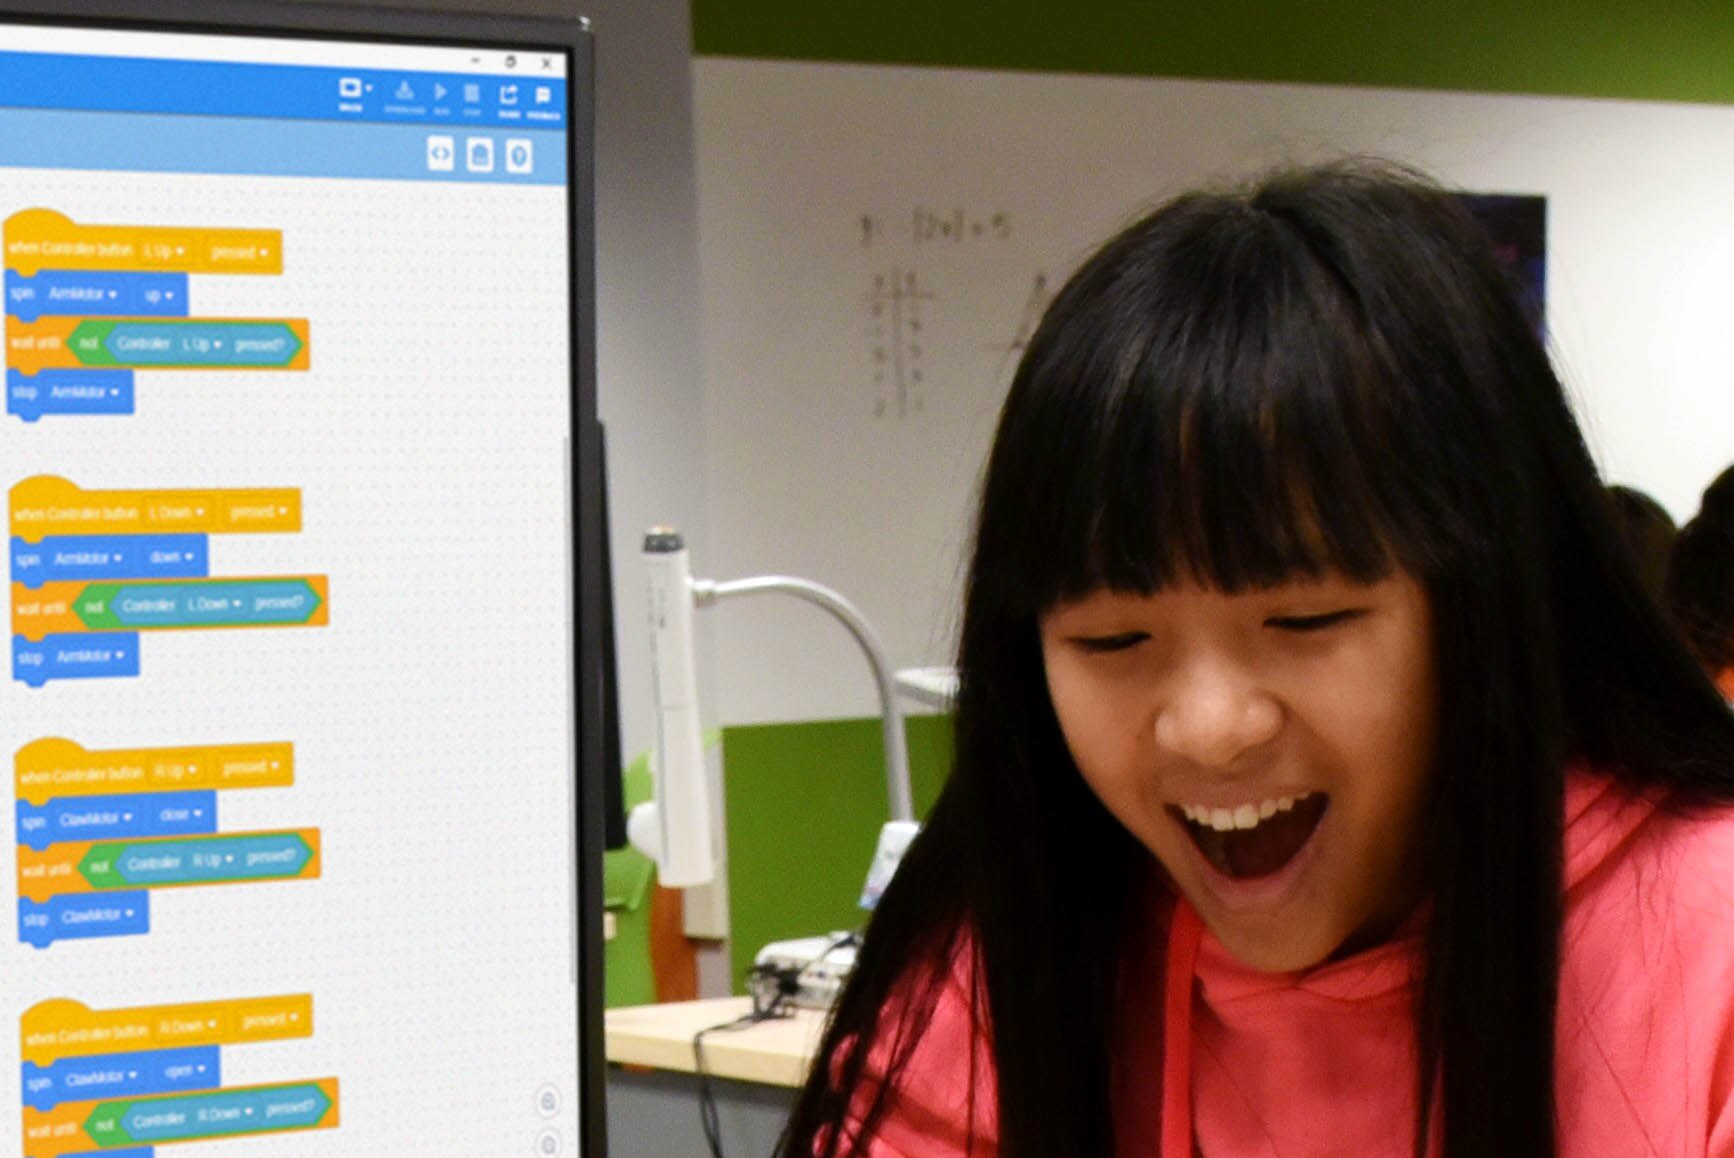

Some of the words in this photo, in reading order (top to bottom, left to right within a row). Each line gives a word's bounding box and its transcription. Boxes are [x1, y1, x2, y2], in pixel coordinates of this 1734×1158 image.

[41, 242, 96, 256] Controller
[79, 338, 98, 350] not
[117, 336, 171, 351] Controller
[12, 385, 37, 400] stop
[49, 507, 100, 520] Controller
[151, 550, 179, 563] down
[85, 602, 103, 614] not
[123, 599, 175, 613] Controller
[18, 651, 43, 666] stop
[53, 769, 106, 783] Controller
[90, 861, 110, 874] not
[127, 857, 182, 872] Controller
[23, 913, 49, 929] stop
[58, 1028, 112, 1043] Controller
[165, 1066, 193, 1081] open
[95, 1119, 114, 1132] not
[133, 1113, 186, 1128] Controller
